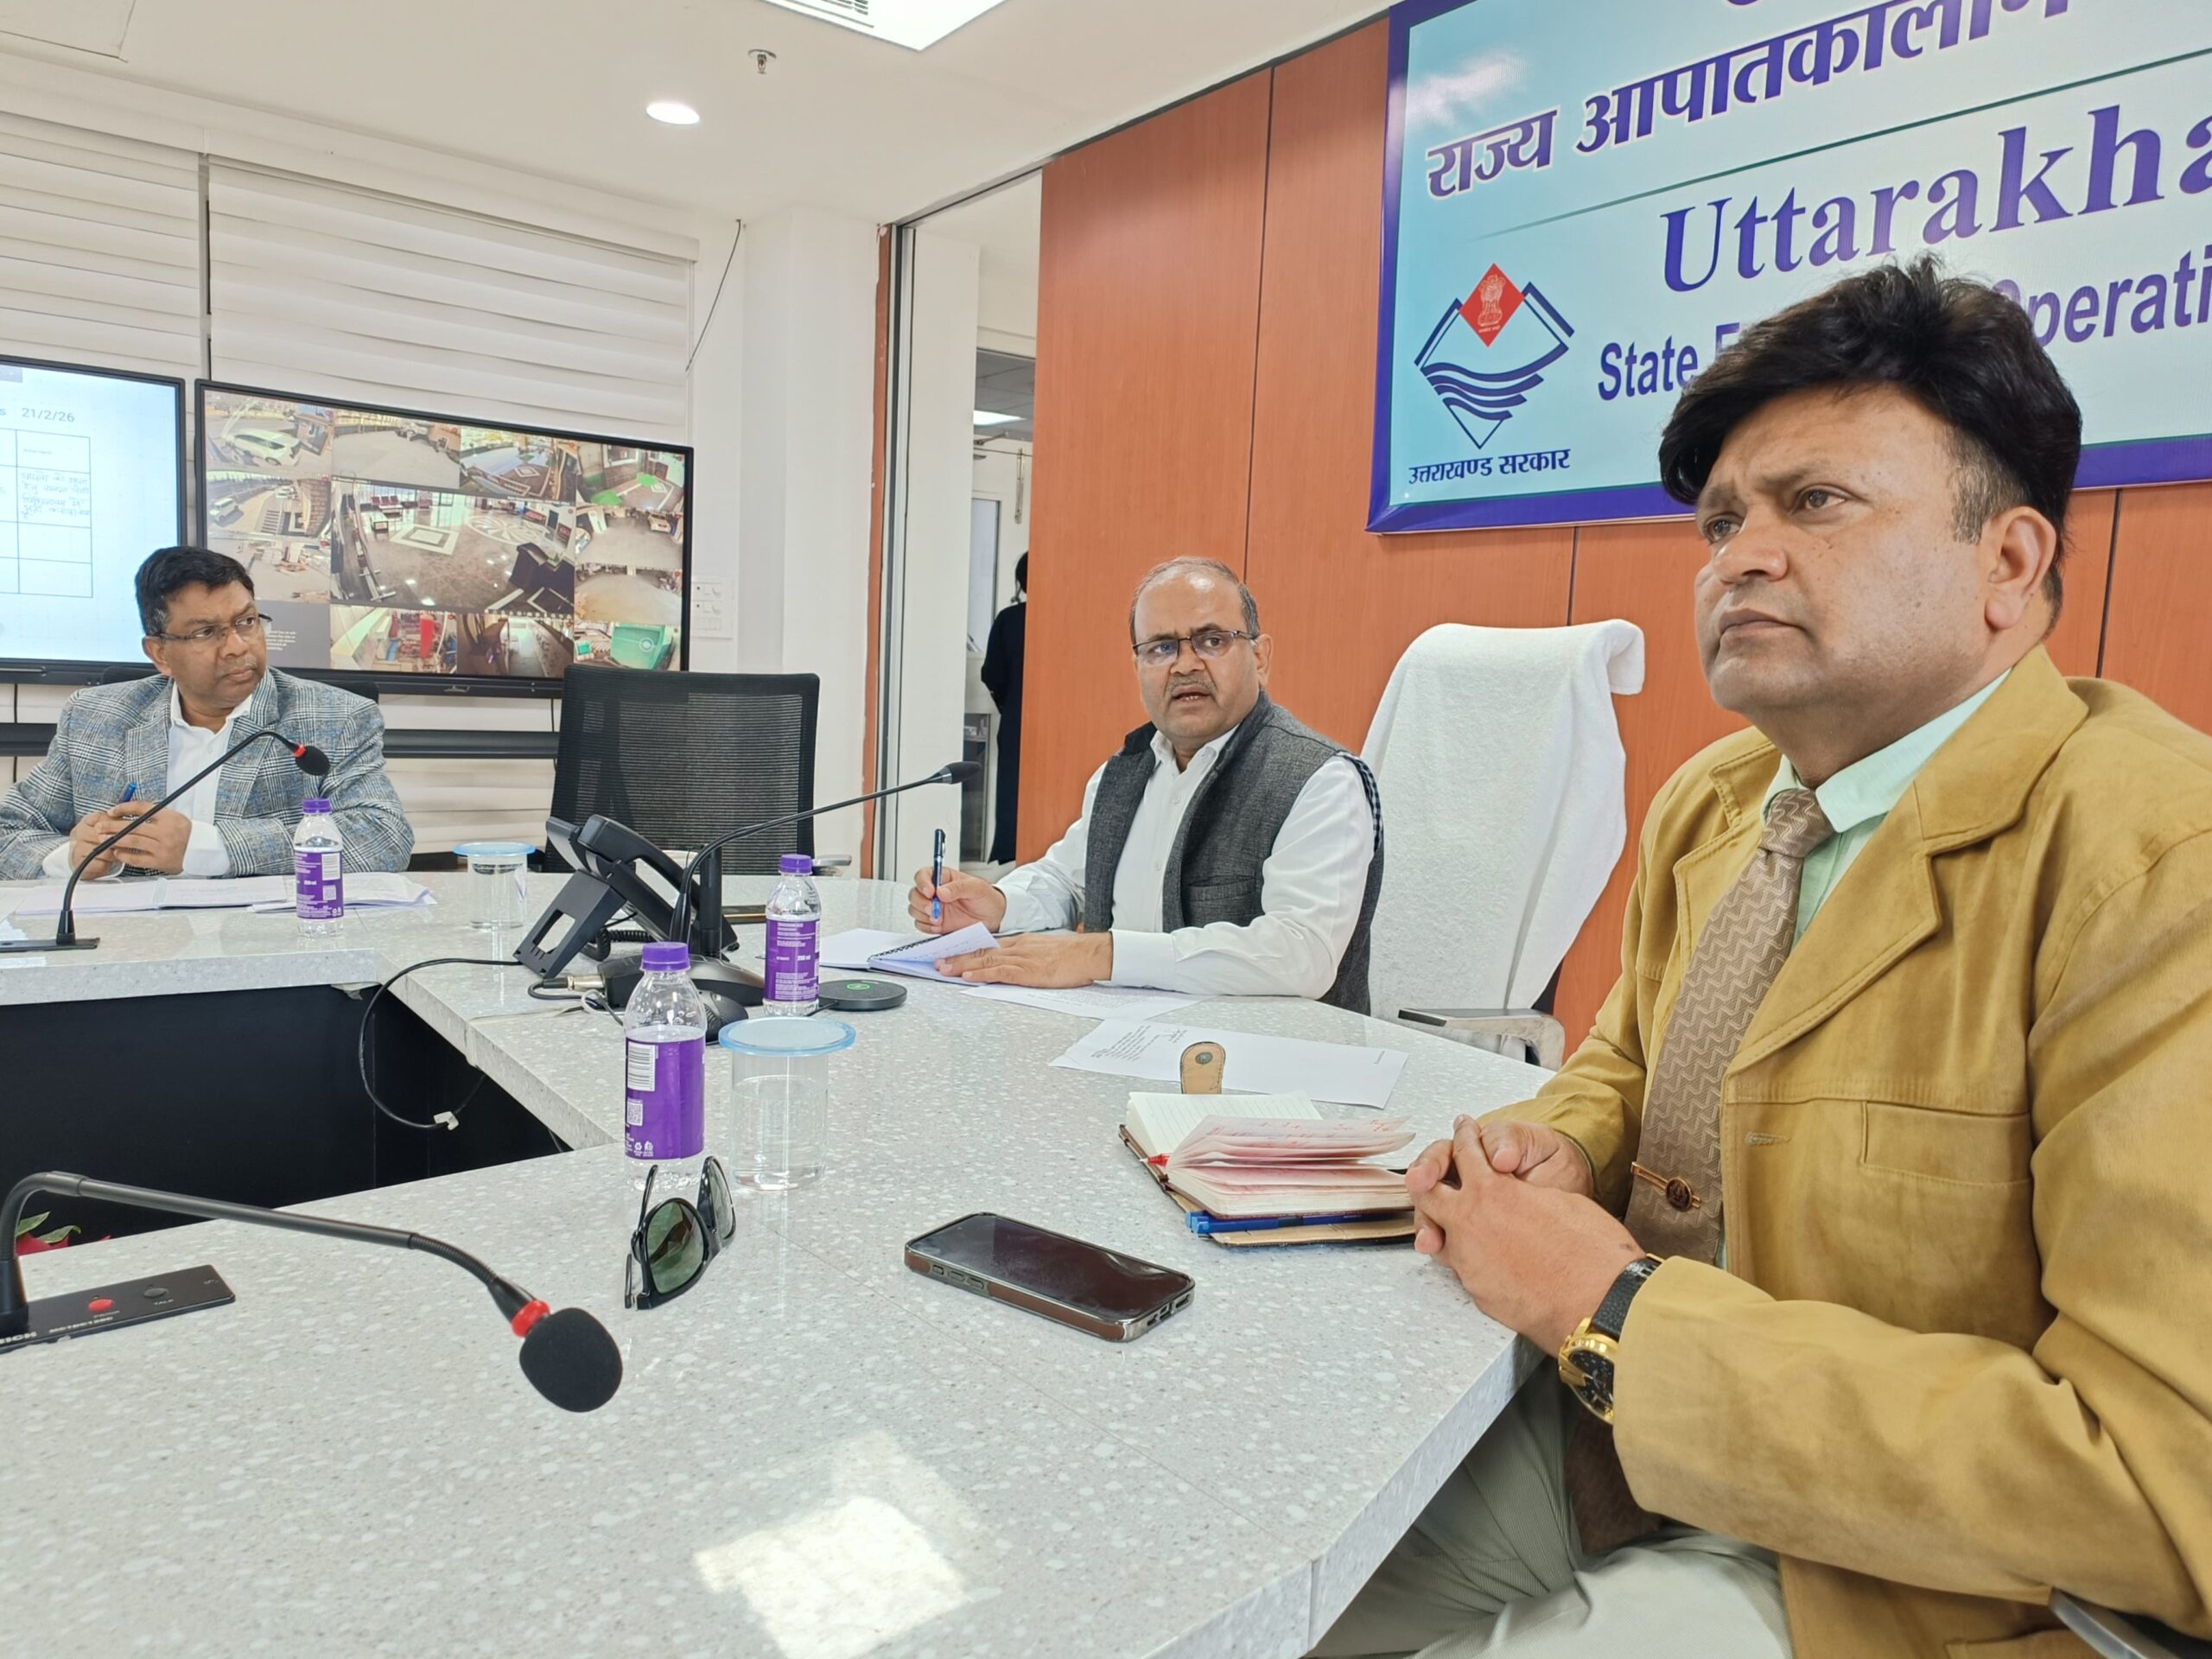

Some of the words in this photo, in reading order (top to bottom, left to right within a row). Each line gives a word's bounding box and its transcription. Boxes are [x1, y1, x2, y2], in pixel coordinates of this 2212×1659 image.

[1427, 109, 1558, 198] राज्य
[1575, 0, 2069, 153] आपातकाली
[1659, 104, 2212, 293] Uttarakha
[1598, 334, 1699, 401] State
[21, 407, 75, 423] 21/2/26
[1408, 457, 1493, 485] उत्तराखण्ड
[1498, 448, 1571, 474] सरकार
